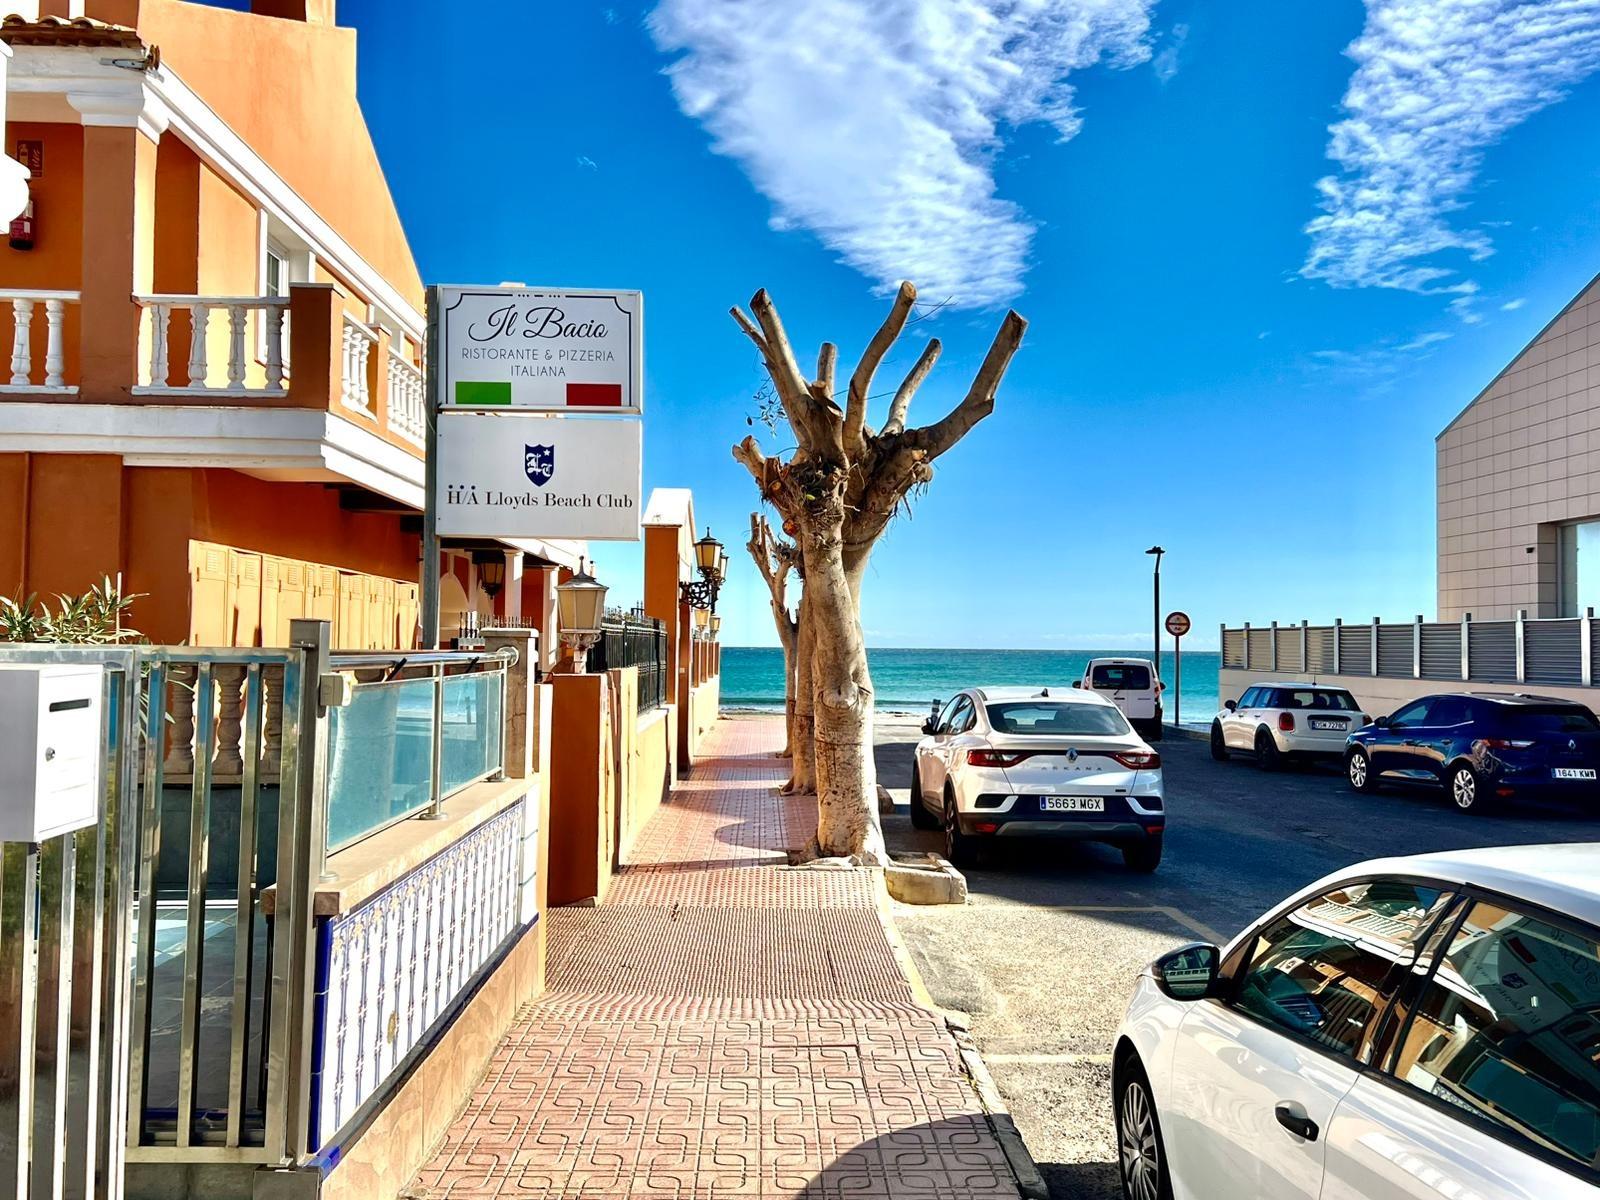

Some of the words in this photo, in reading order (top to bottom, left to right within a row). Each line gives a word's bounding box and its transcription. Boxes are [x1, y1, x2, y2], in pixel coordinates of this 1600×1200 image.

[468, 304, 519, 342] Il
[522, 306, 608, 339] Bacio
[461, 347, 539, 361] RISTORANTE
[544, 350, 553, 361] &
[558, 350, 615, 362] PIZZERIA
[510, 365, 566, 377] ITALIANA
[485, 492, 539, 509] Lloyds
[544, 492, 592, 508] Beach
[596, 493, 633, 508] Club
[1047, 797, 1076, 809] 5663
[1079, 798, 1101, 810] MGX
